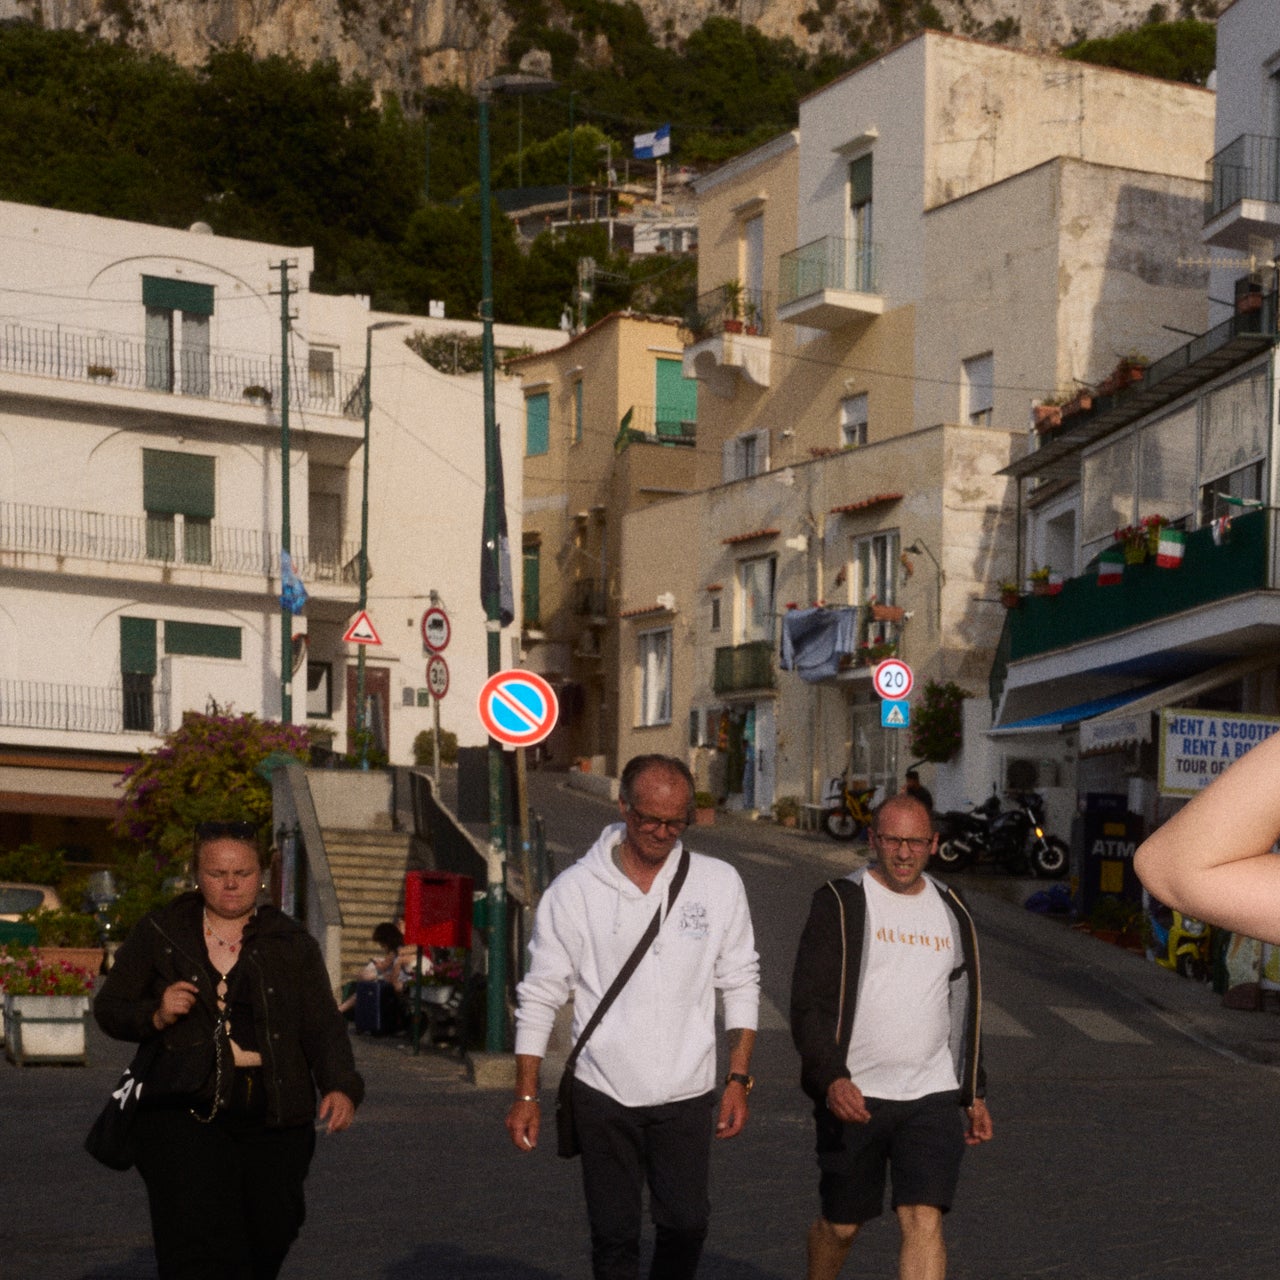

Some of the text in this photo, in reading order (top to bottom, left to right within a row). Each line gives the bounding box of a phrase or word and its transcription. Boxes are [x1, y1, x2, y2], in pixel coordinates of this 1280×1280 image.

[884, 671, 904, 688] 20
[1169, 718, 1204, 736] RENT
[1208, 721, 1217, 737] A
[1183, 738, 1258, 758] RENT A BO
[1176, 758, 1225, 774] TOUR OF
[1091, 839, 1136, 858] ATM
